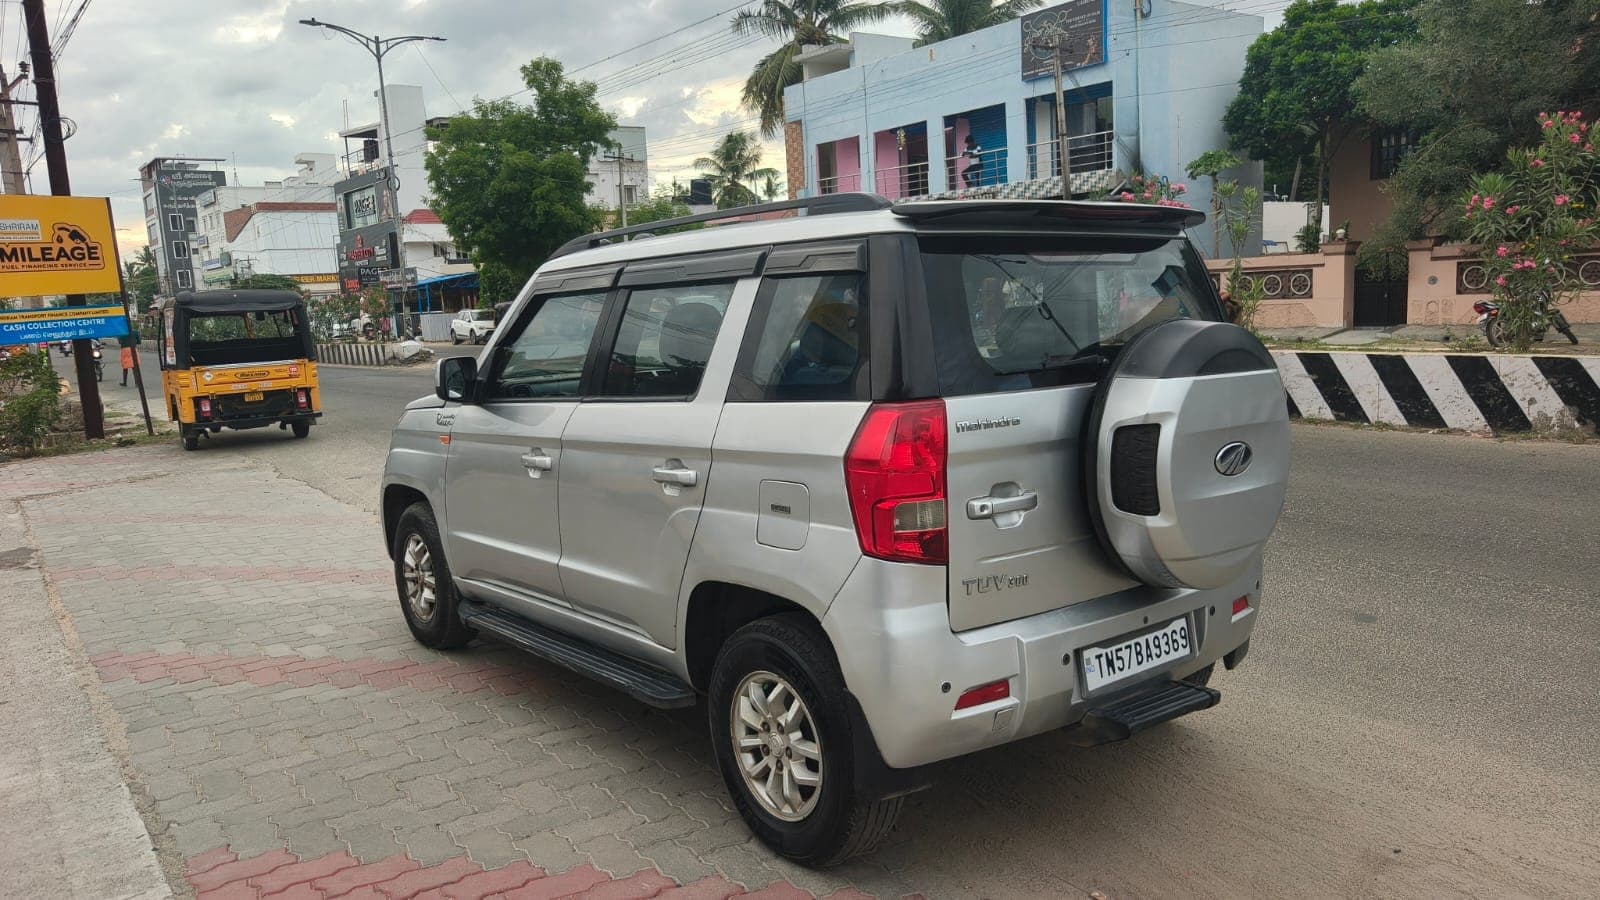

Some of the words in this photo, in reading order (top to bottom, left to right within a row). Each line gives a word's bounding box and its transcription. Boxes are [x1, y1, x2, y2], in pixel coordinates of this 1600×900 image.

[0, 222, 38, 231] SHRIRAM
[0, 246, 100, 263] MILEAGE
[3, 324, 26, 332] CASH
[27, 320, 76, 330] COLLECTION
[77, 318, 106, 326] CENTRE
[1095, 626, 1188, 678] TN57BA9369
